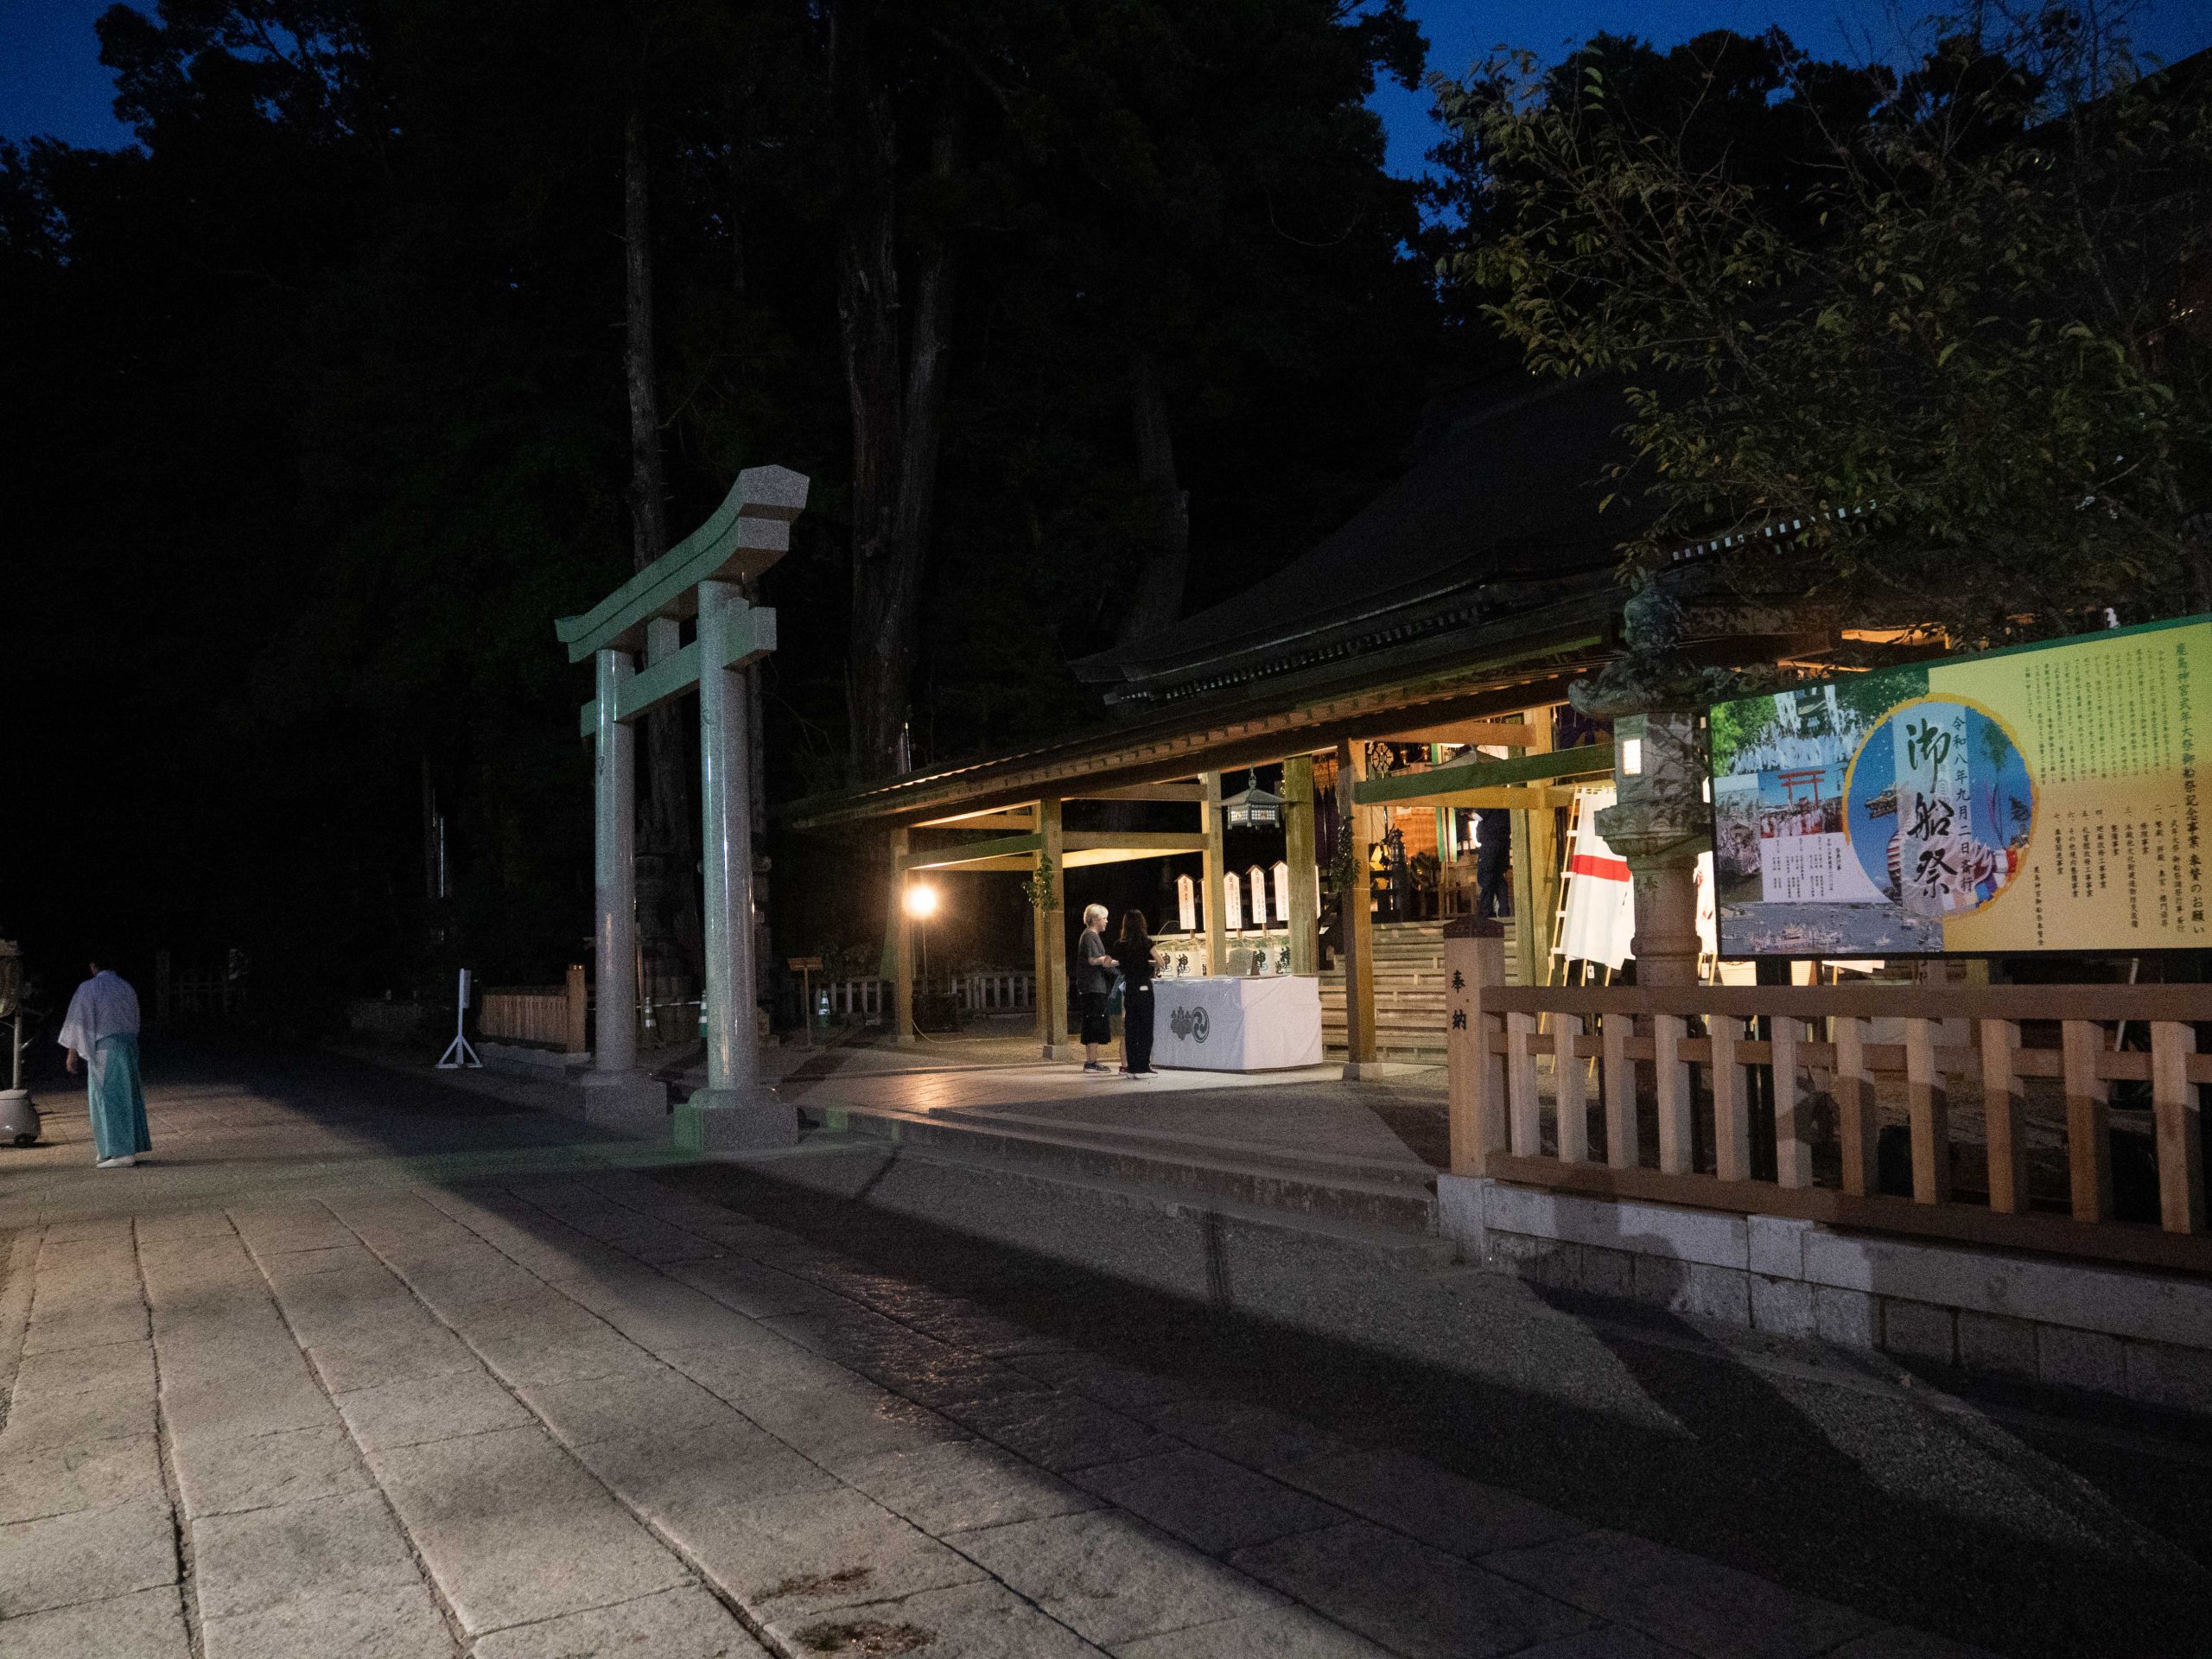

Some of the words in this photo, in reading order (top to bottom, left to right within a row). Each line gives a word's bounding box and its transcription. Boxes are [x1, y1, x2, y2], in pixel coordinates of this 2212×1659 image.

[1906, 717, 1958, 899] 御船祭
[1951, 715, 1974, 893] 令和八年九月二日斎行
[1451, 969, 1467, 1031] 奉納
